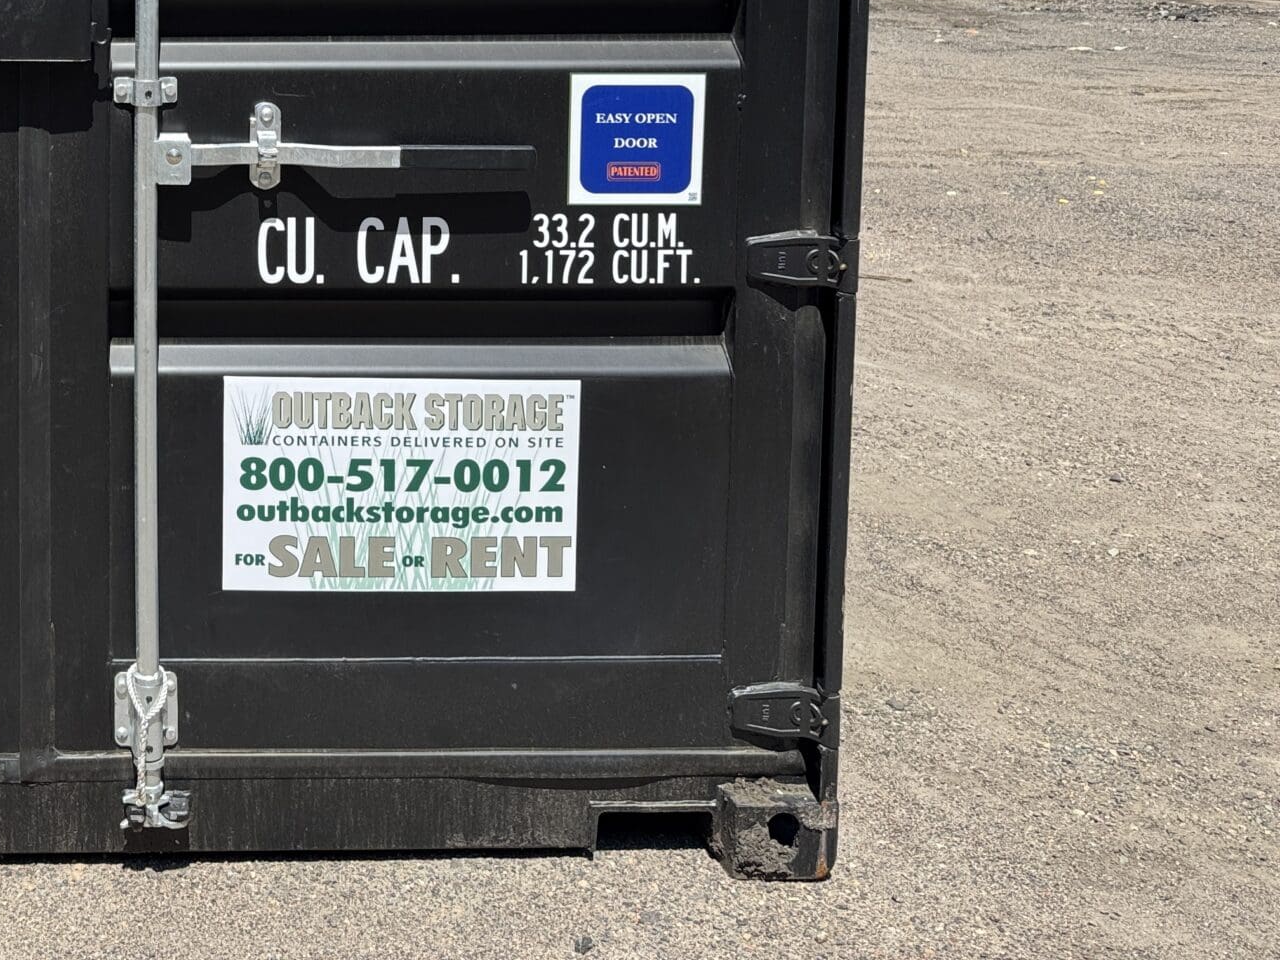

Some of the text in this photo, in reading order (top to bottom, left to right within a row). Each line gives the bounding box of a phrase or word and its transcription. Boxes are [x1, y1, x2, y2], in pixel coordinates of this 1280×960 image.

[595, 113, 677, 124] EASY OPEN
[613, 138, 658, 149] DOOR
[610, 166, 657, 177] PATENTED
[257, 212, 684, 285] CU. CAP. 33.2 CU.M.
[519, 248, 701, 284] 1,172 CU.FT.
[271, 391, 565, 431] OUTBACK STORAGE
[272, 435, 564, 448] CONTAINERS DELIVERED ON SITE
[239, 457, 567, 492] 800-517-0012
[236, 497, 563, 529] outbackstorage.com
[235, 535, 573, 578] FOR SALE OR RENT
